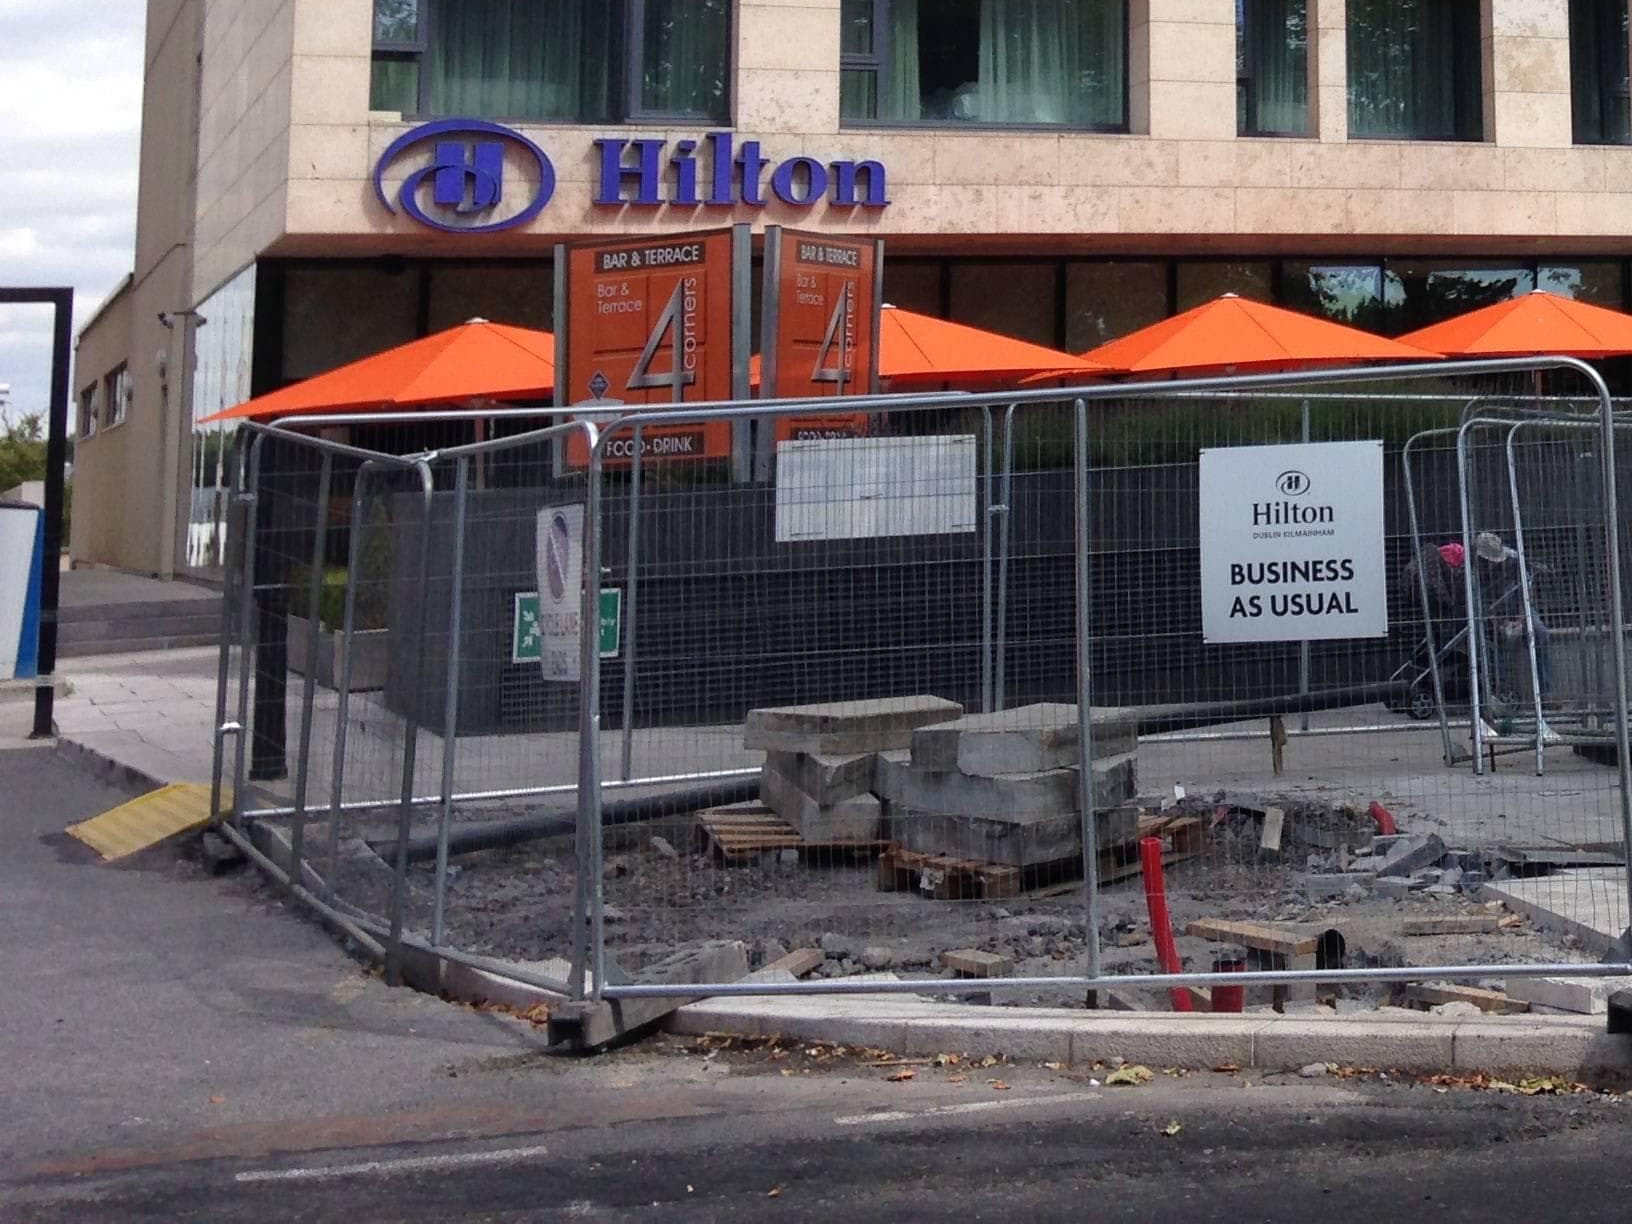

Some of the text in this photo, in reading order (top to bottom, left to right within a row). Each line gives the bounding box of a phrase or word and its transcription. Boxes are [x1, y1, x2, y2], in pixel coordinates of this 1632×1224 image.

[594, 132, 892, 206] Hilton
[603, 245, 699, 269] BAR & TERRACE
[801, 244, 857, 266] BAR & TERRACE
[597, 282, 629, 297] Bar &
[598, 299, 642, 313] Terrace
[684, 278, 696, 369] corners
[626, 277, 695, 403] 4
[1252, 501, 1334, 526] Hilton
[1253, 530, 1281, 539] DUBLIN
[1231, 559, 1354, 585] BUSINESS
[1229, 591, 1358, 618] AS USUAL
